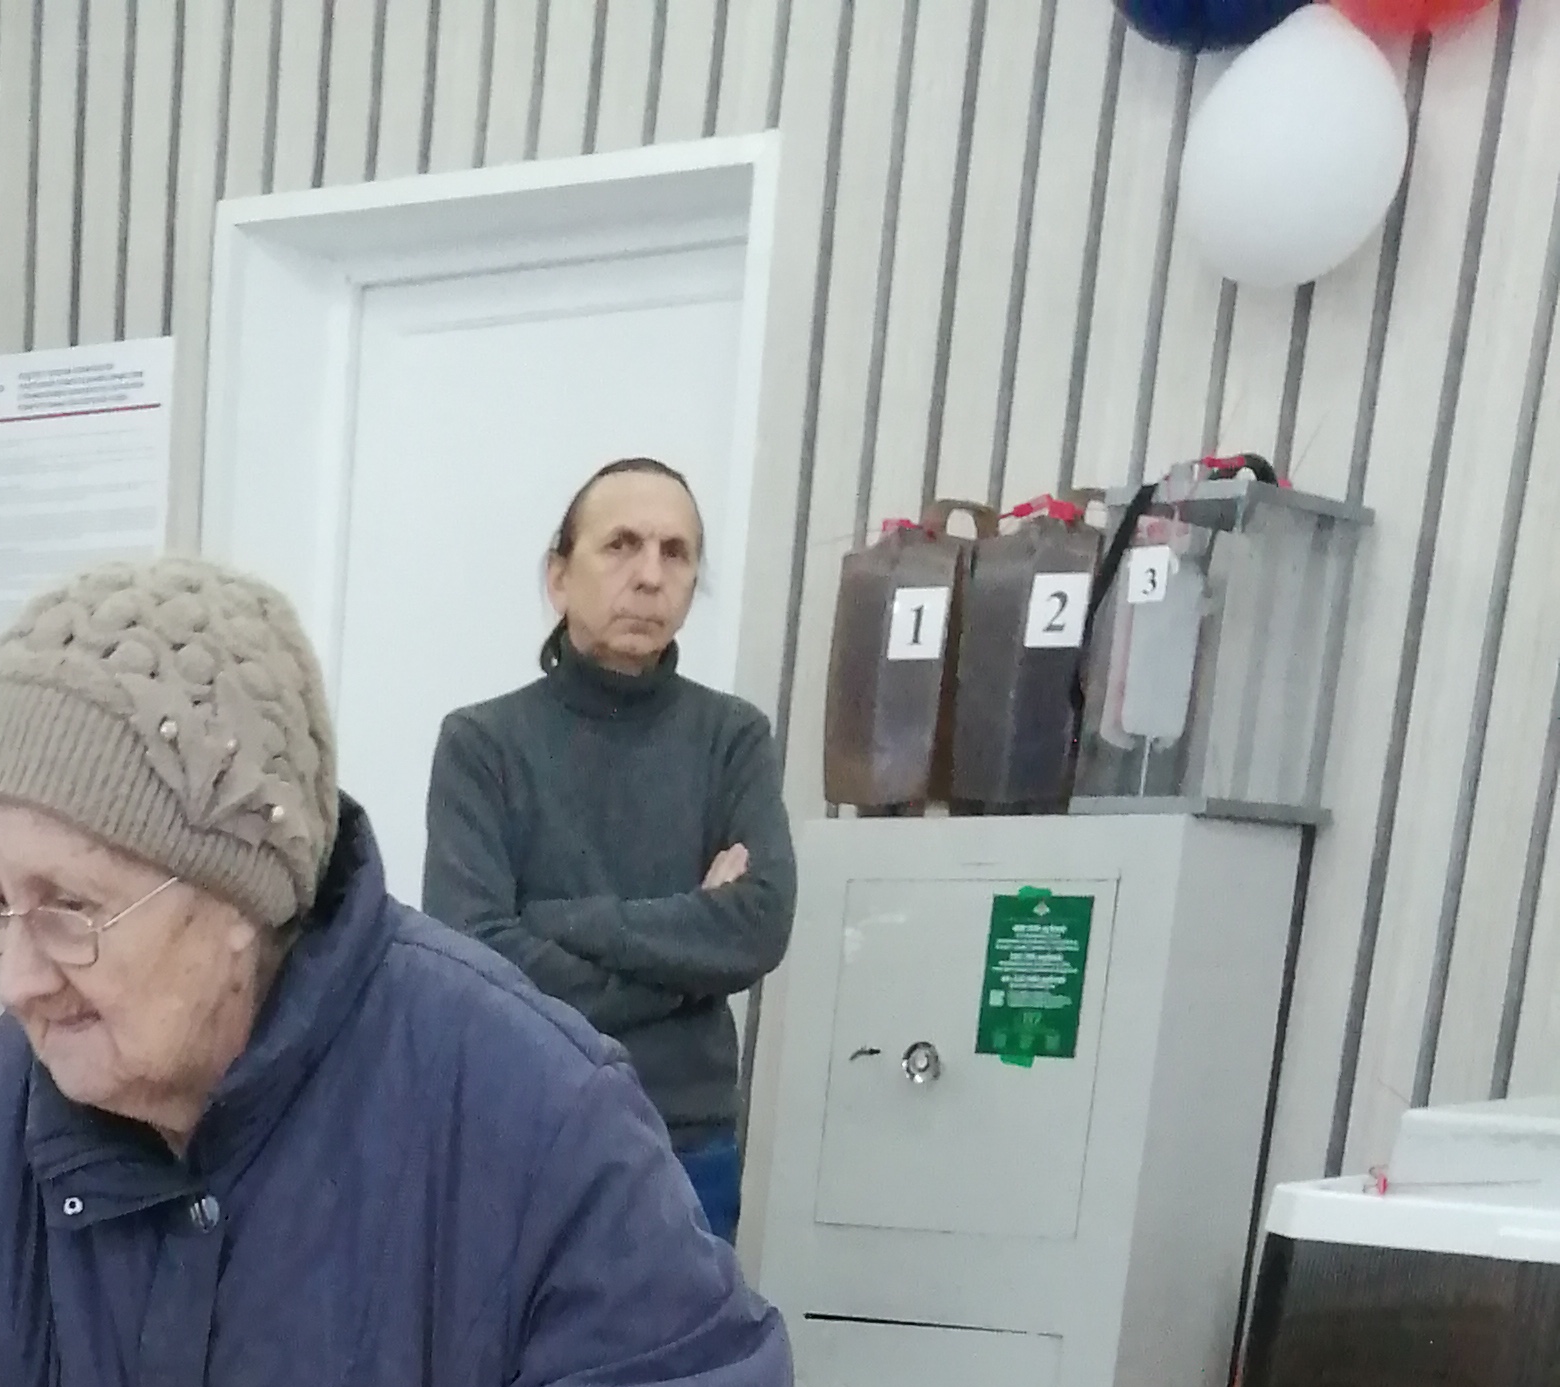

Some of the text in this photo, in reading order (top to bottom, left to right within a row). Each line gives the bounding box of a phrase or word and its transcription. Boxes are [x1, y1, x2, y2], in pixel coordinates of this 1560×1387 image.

[1142, 568, 1156, 595] 3
[907, 604, 925, 645] 1
[1042, 591, 1068, 632] 2
